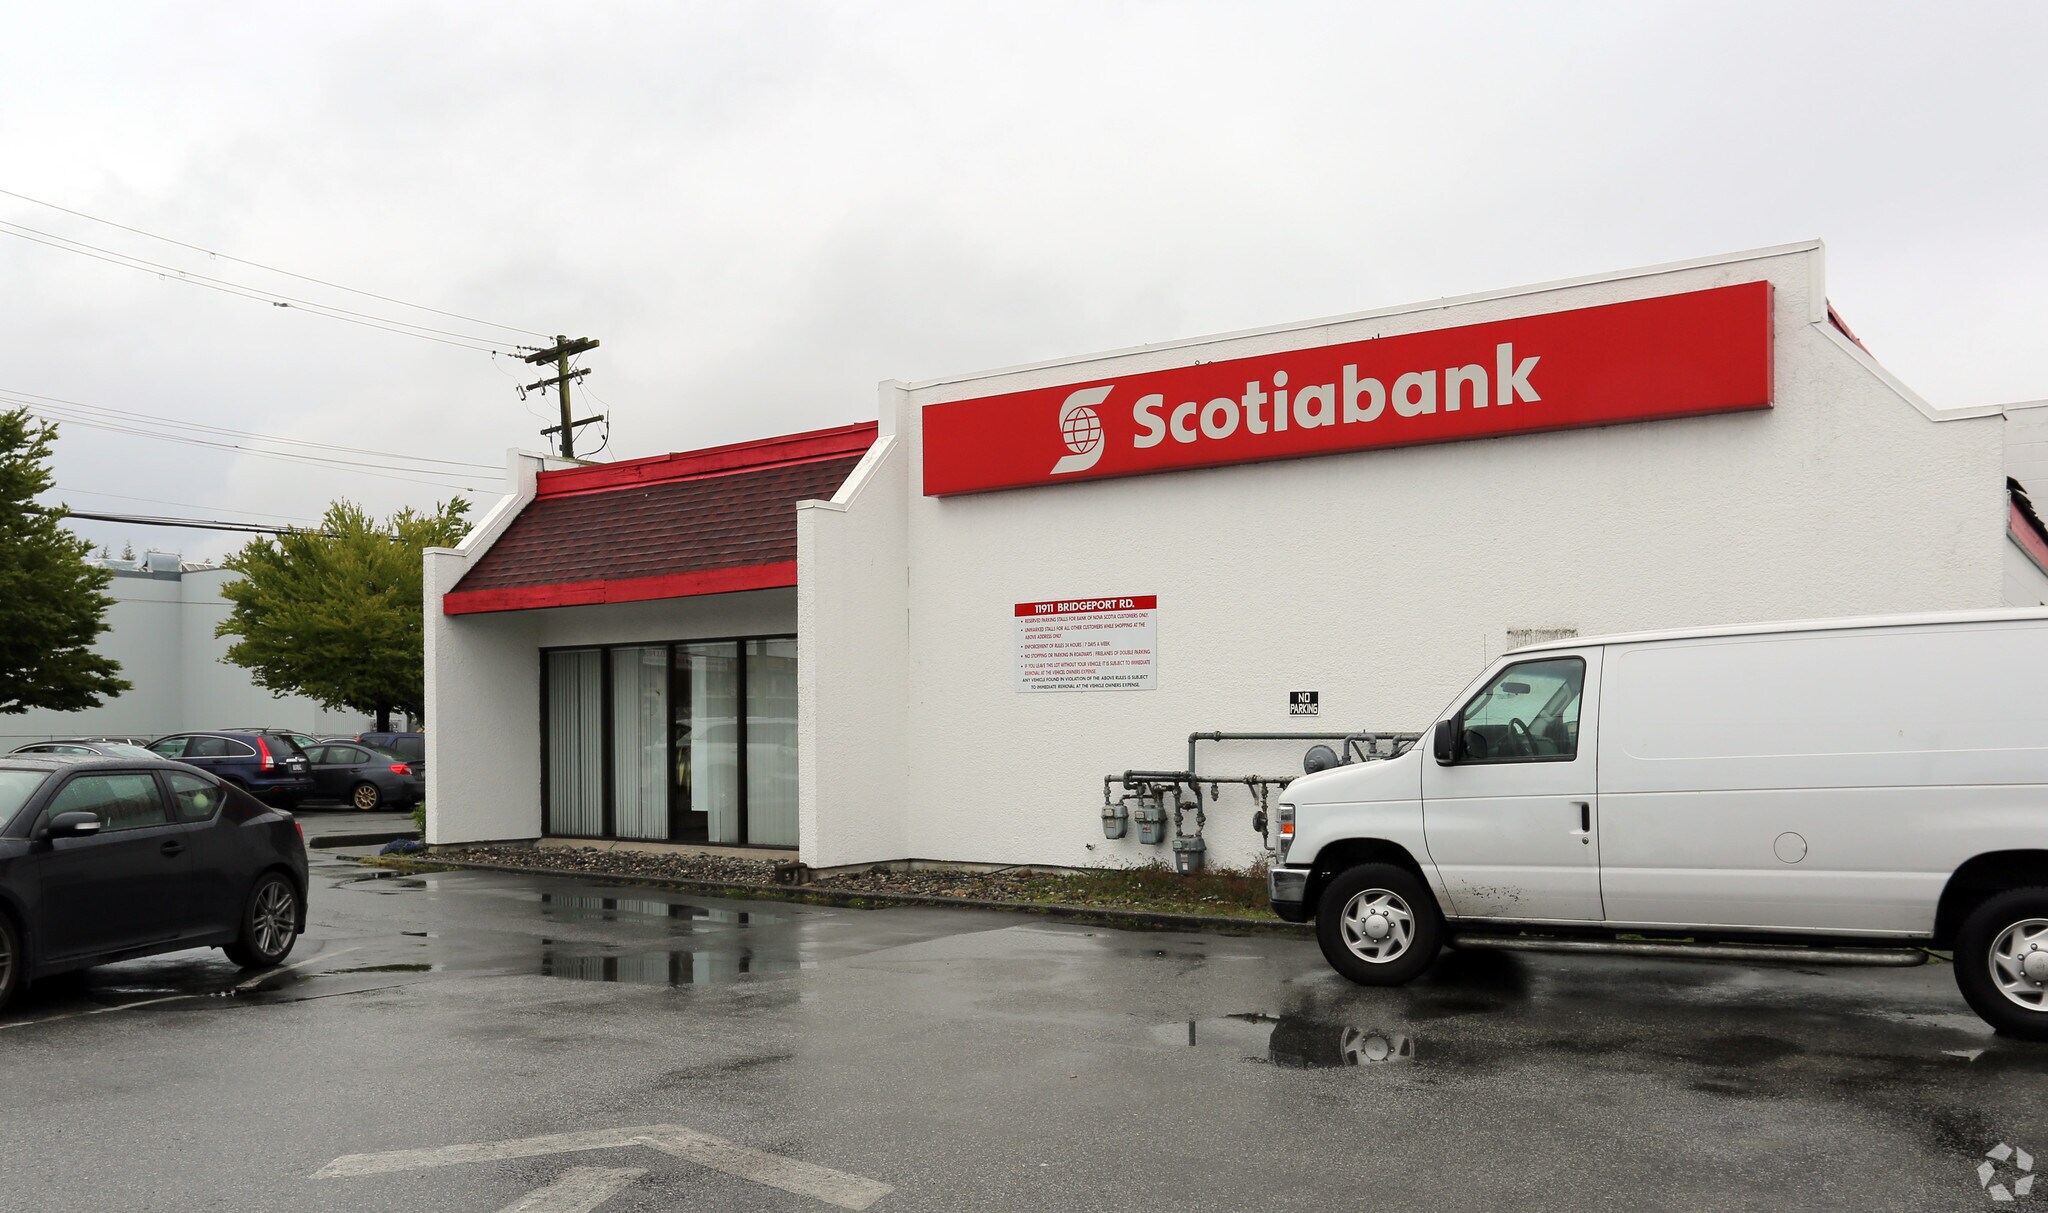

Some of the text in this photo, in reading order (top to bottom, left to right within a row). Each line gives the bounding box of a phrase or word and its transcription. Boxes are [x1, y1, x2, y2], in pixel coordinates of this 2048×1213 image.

[1132, 342, 1542, 449] Scotiabank
[1034, 599, 1135, 613] 11911 BRIDGEPORT RD.
[1298, 692, 1310, 703] NO
[1290, 703, 1318, 714] PARKING
